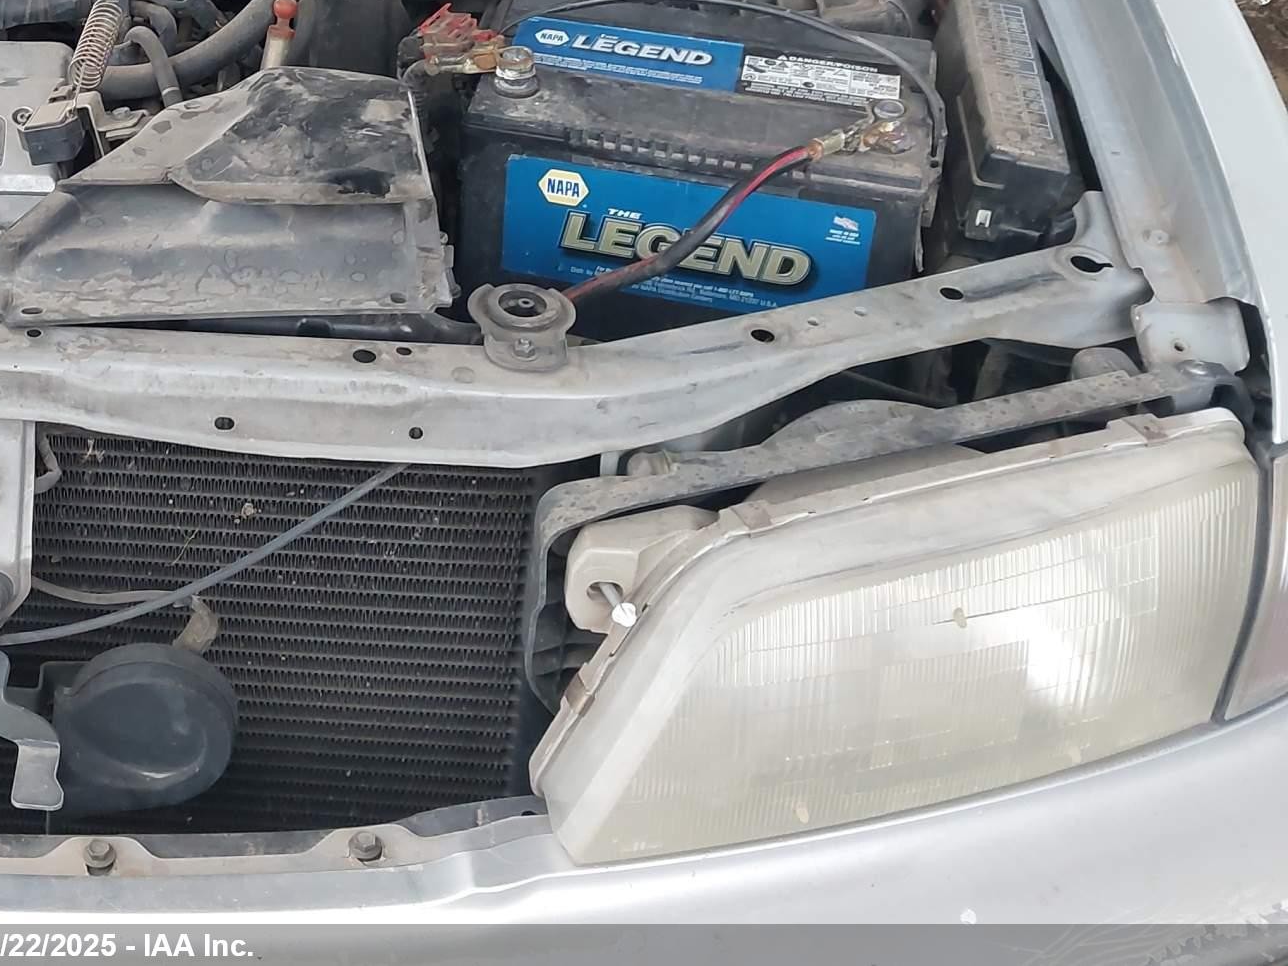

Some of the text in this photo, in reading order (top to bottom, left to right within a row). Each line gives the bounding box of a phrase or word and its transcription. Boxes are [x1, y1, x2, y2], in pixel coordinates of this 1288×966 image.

[540, 32, 566, 44] NAPA
[571, 34, 713, 66] LEGEND
[546, 177, 580, 198] NAPA
[607, 207, 641, 221] THE
[560, 210, 813, 286] LEGEND
